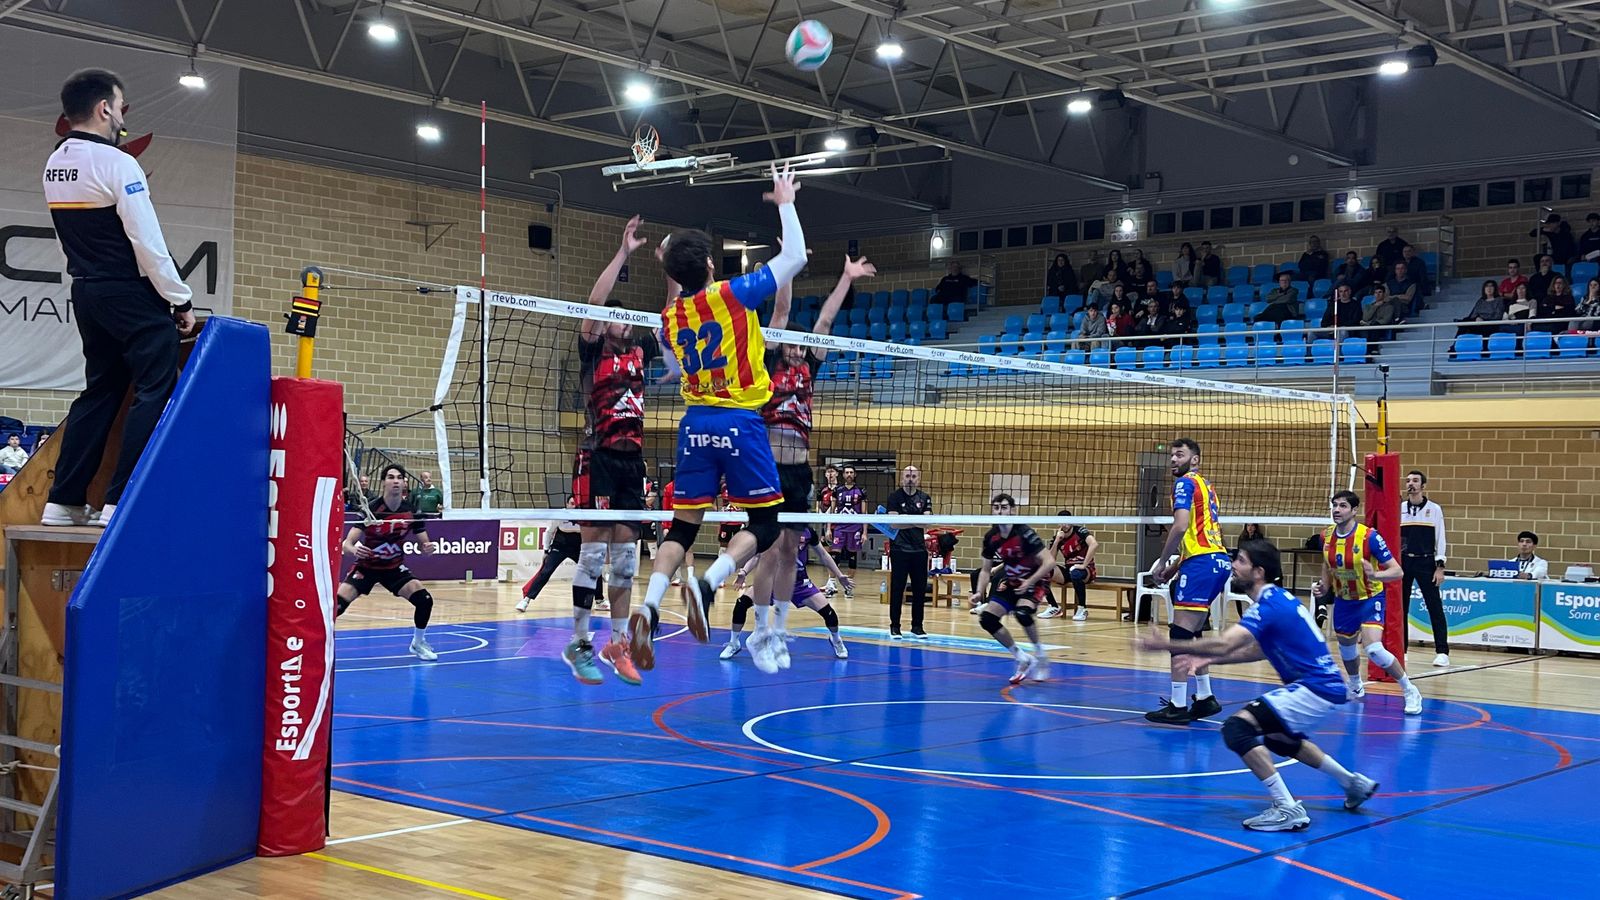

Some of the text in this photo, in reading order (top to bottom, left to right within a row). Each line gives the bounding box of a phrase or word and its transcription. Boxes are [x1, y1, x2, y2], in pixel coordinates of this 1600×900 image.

[45, 168, 79, 182] RFEVB
[492, 293, 537, 308] rfevb.com
[608, 308, 649, 322] rfevb.com
[802, 334, 836, 346] rfevb.com
[885, 345, 914, 355] rfevb.com
[958, 352, 986, 362] rfevb.com
[677, 320, 728, 375] 32
[687, 433, 733, 449] TIPSA
[1179, 574, 1188, 588] 6
[1555, 591, 1600, 609] Espor
[1442, 604, 1472, 616] equip!
[1568, 608, 1592, 620] Som
